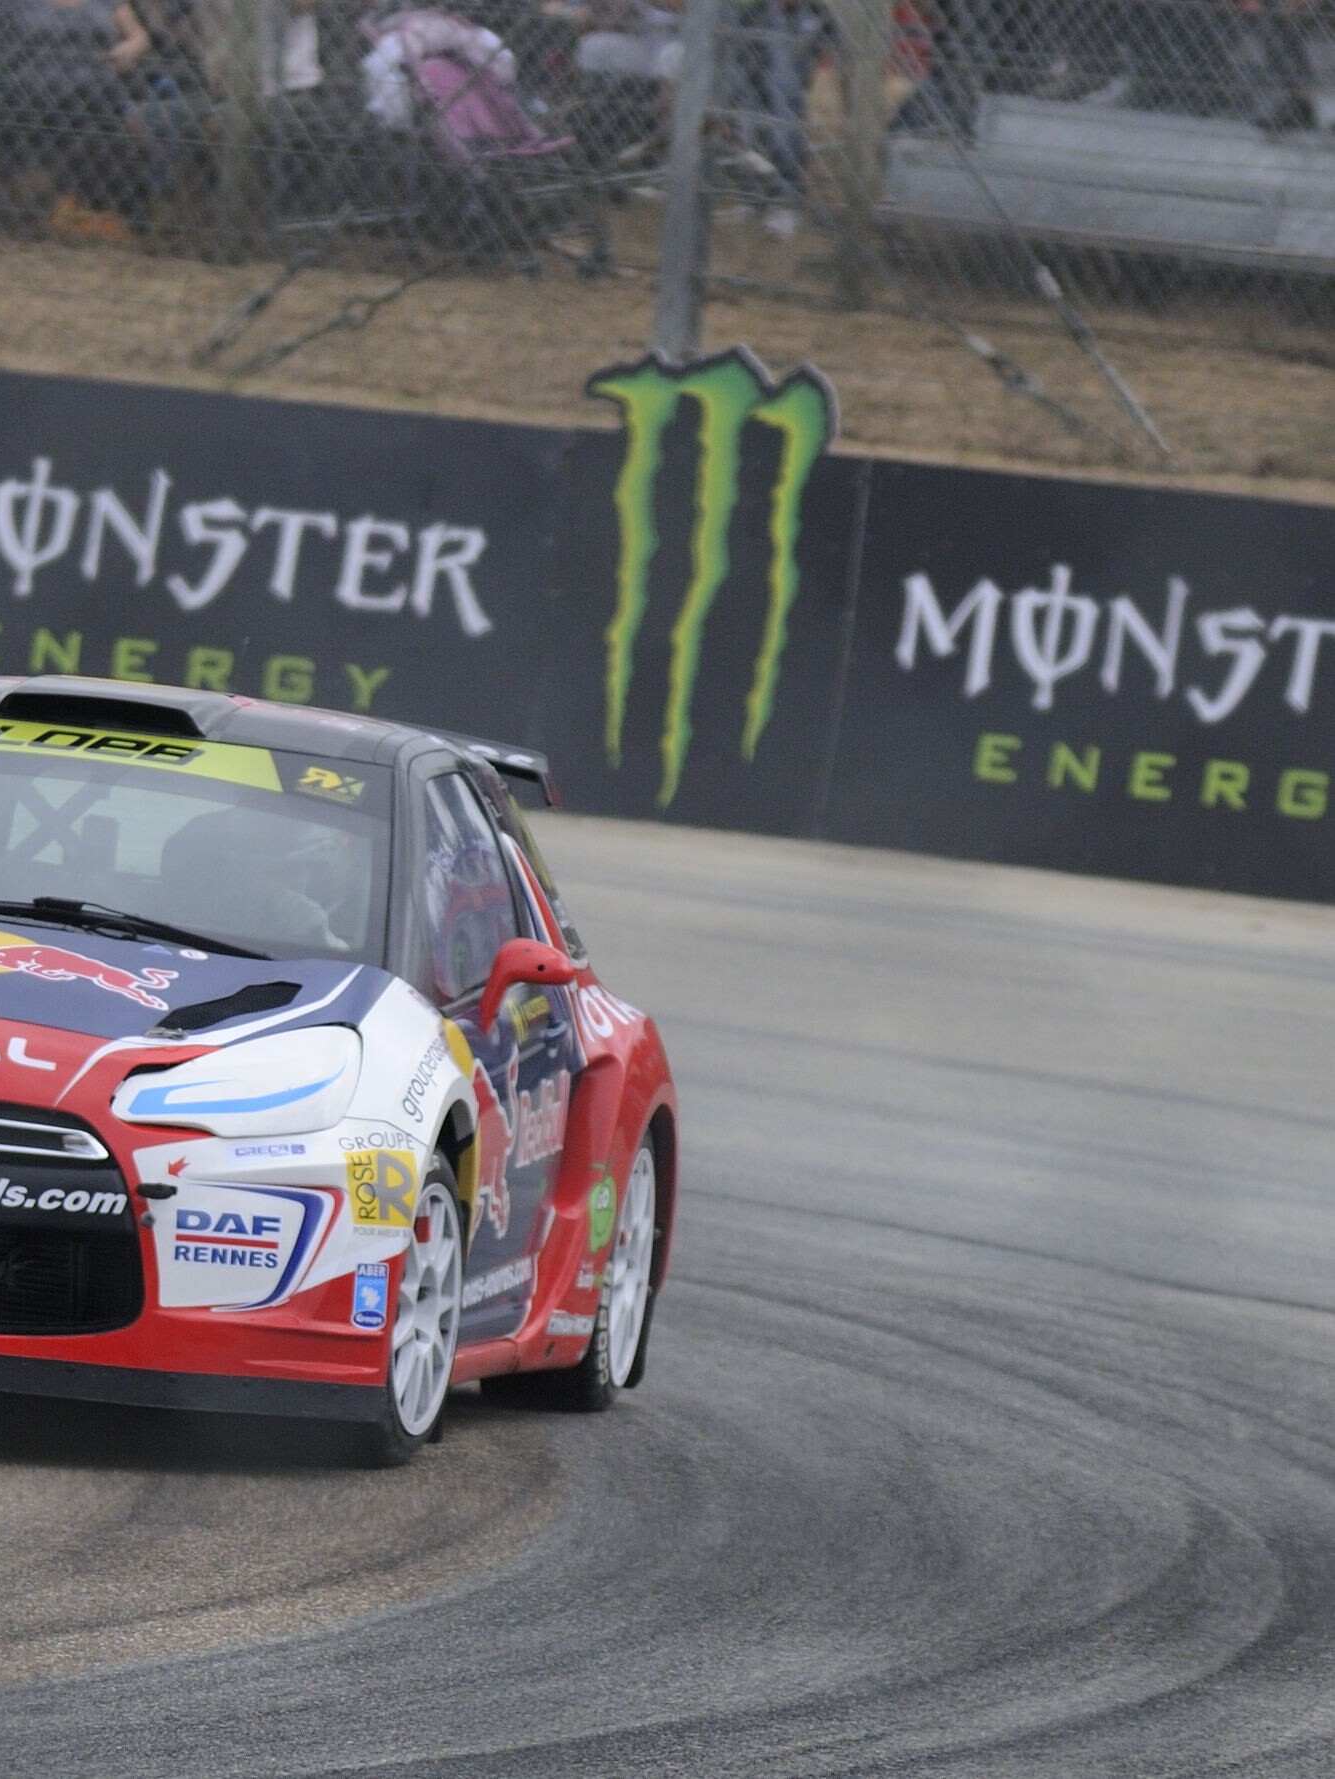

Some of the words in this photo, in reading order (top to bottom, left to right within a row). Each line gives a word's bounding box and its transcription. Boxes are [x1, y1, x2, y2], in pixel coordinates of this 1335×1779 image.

[338, 1131, 416, 1152] GROUPE
[351, 1154, 376, 1221] ROSE
[176, 1208, 282, 1236] DAF
[174, 1244, 279, 1270] RENNES
[358, 1264, 387, 1277] ABER
